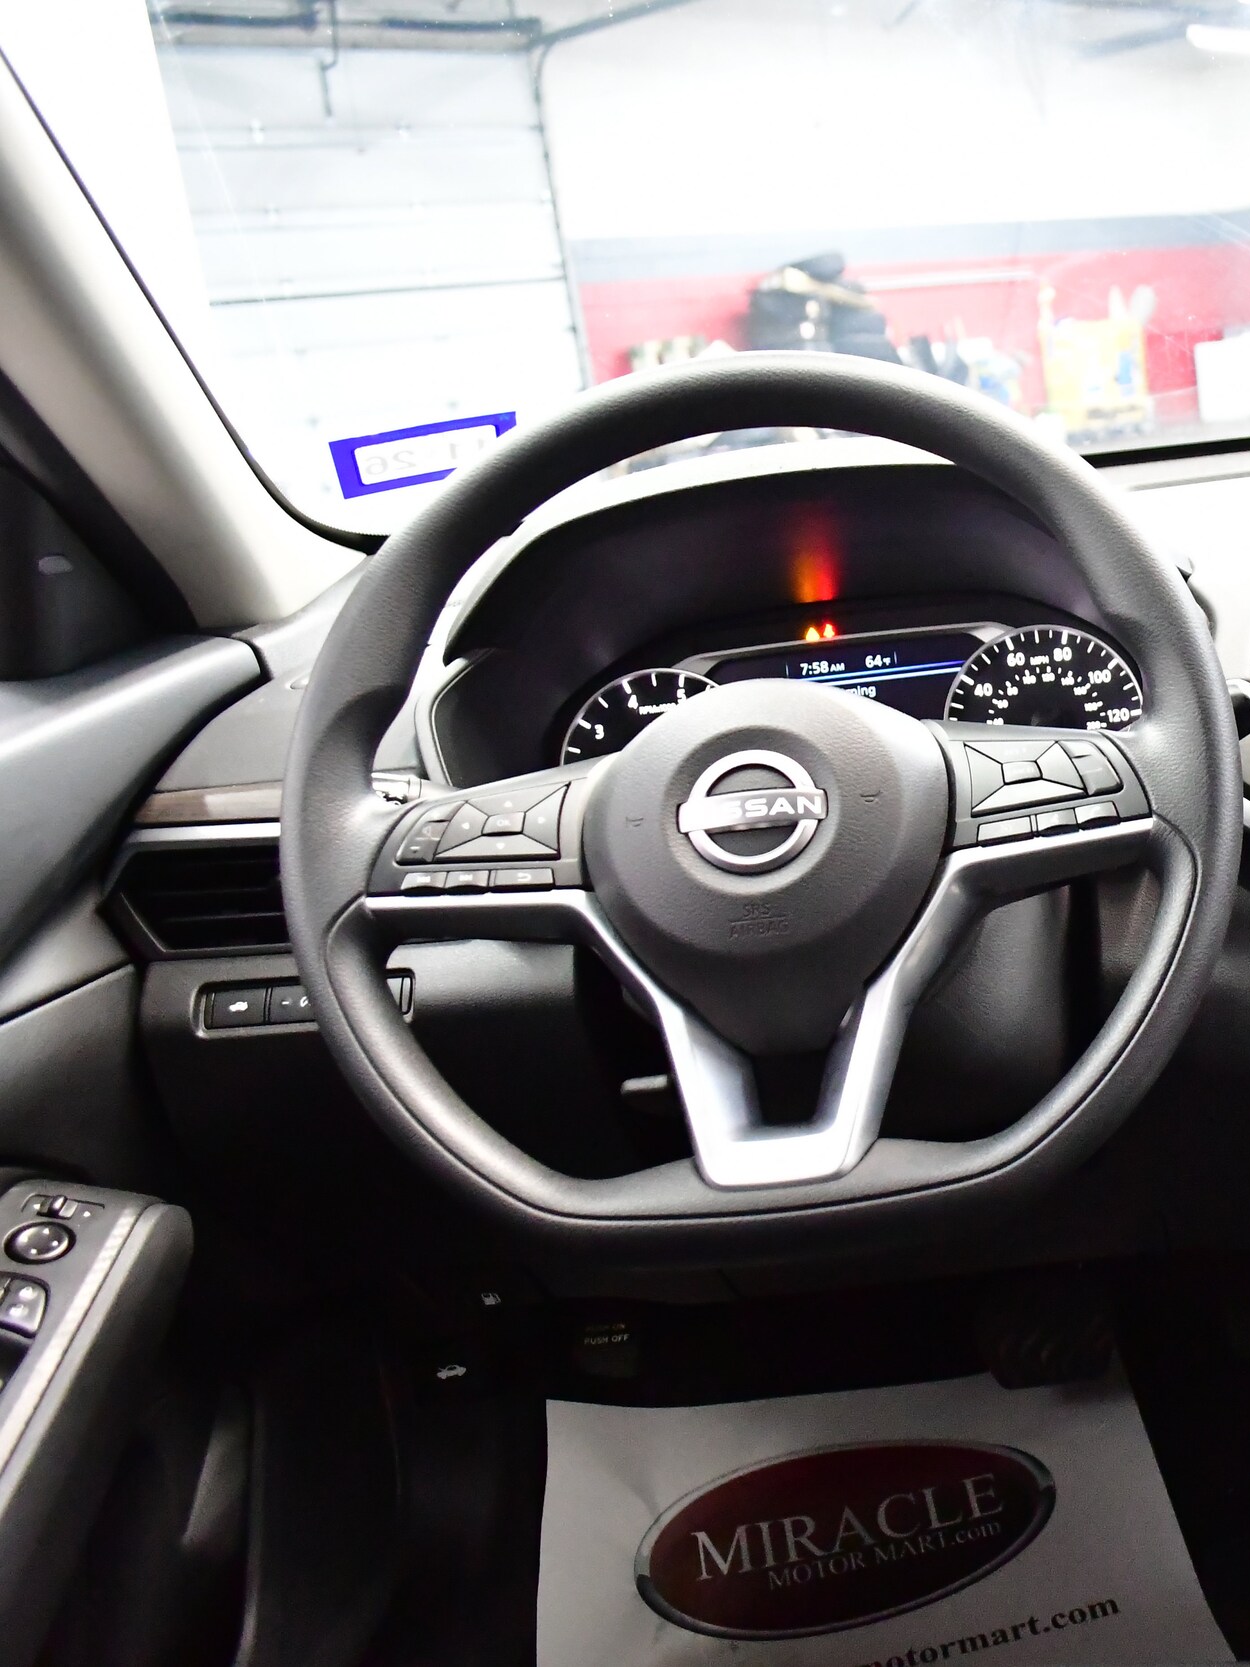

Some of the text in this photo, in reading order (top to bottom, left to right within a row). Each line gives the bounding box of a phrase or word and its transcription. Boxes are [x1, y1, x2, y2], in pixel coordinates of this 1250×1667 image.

[1006, 651, 1026, 667] 60
[1053, 646, 1073, 662] 80
[800, 661, 846, 676] 7:58 AM
[1087, 668, 1112, 684] 100
[973, 682, 993, 698] 40
[627, 694, 638, 709] 4
[1107, 707, 1130, 723] 120
[594, 723, 605, 740] 3
[691, 1472, 1003, 1581] MIRACLE
[768, 1520, 1001, 1591] MOTOR MART.com
